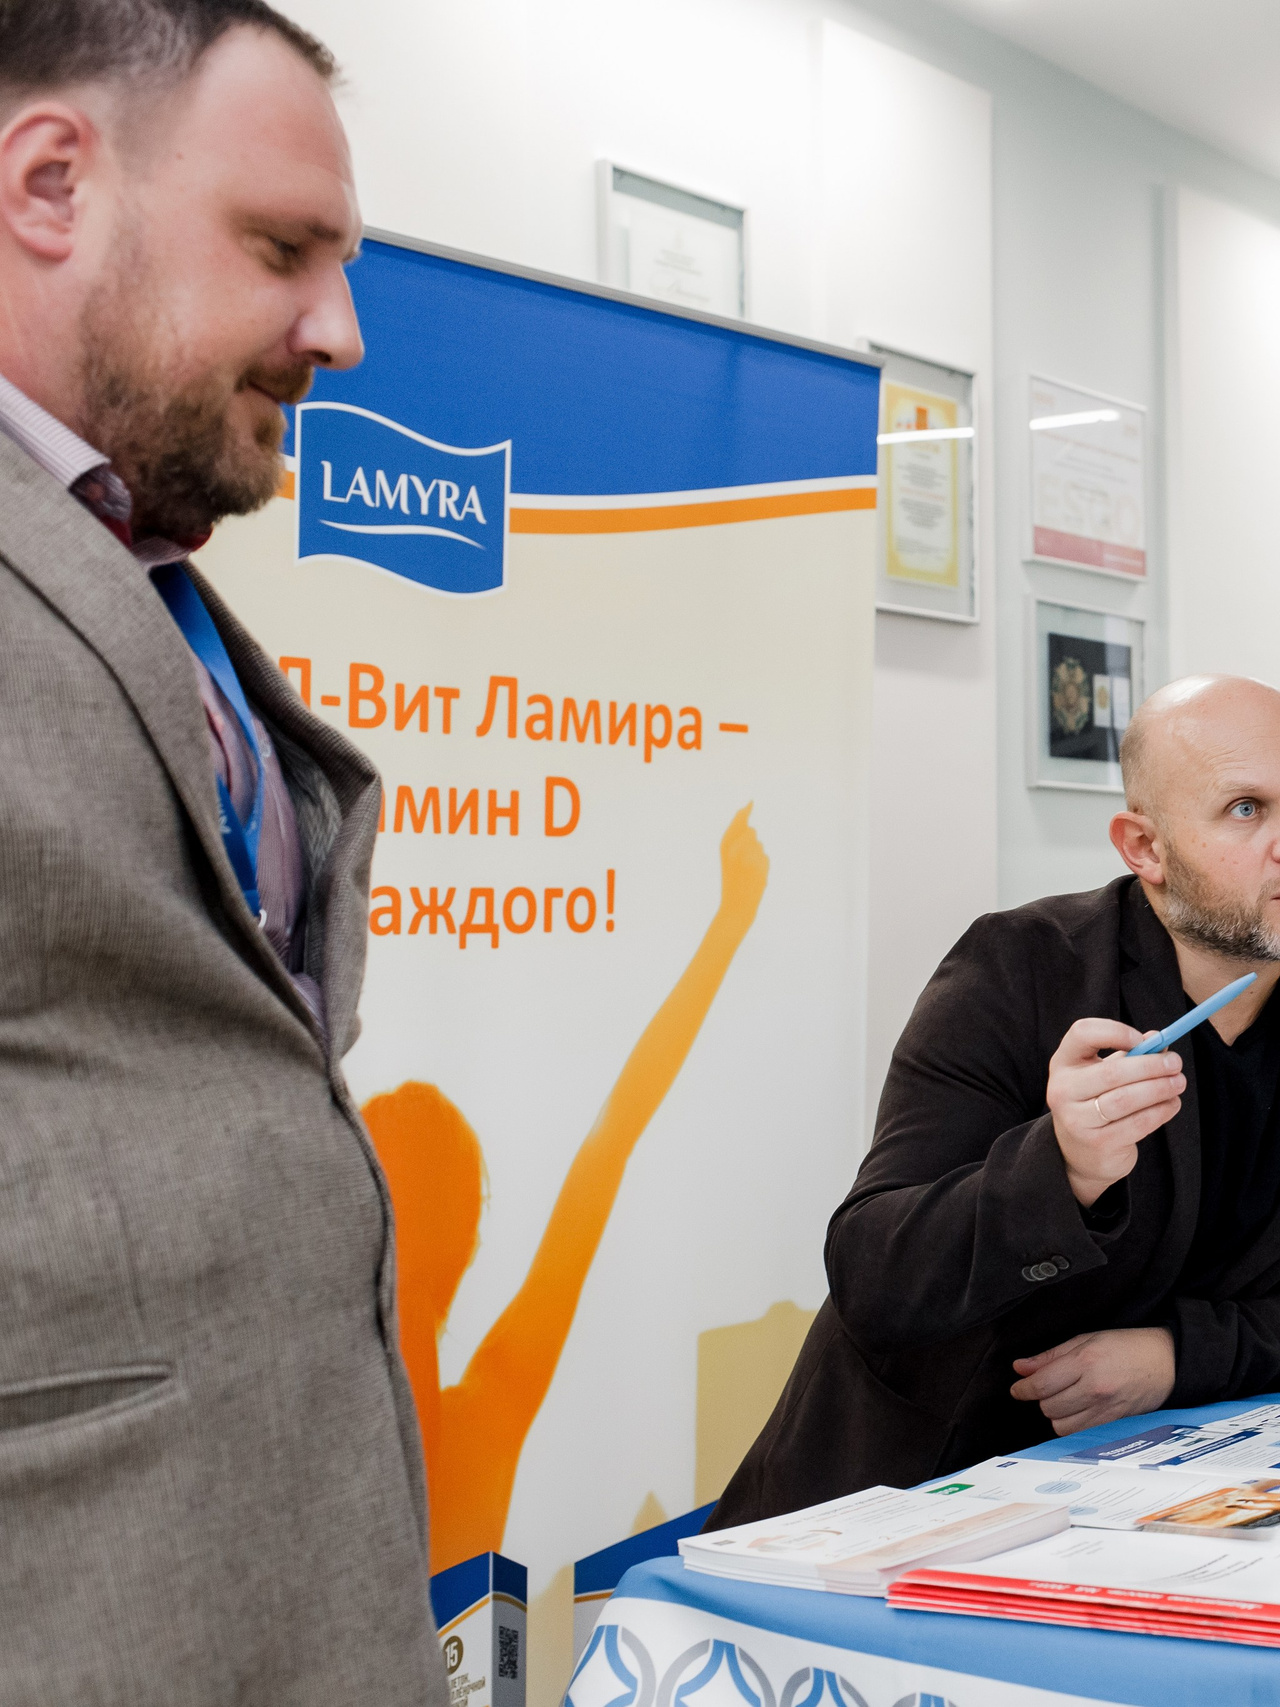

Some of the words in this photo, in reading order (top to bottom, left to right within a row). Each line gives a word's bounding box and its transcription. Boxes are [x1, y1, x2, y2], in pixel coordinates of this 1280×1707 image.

[320, 460, 487, 525] LAMYRA
[476, 675, 702, 763] Ламира
[378, 783, 521, 836] мин
[544, 776, 581, 837] D
[369, 868, 616, 949] аждого!
[445, 1641, 459, 1669] 15
